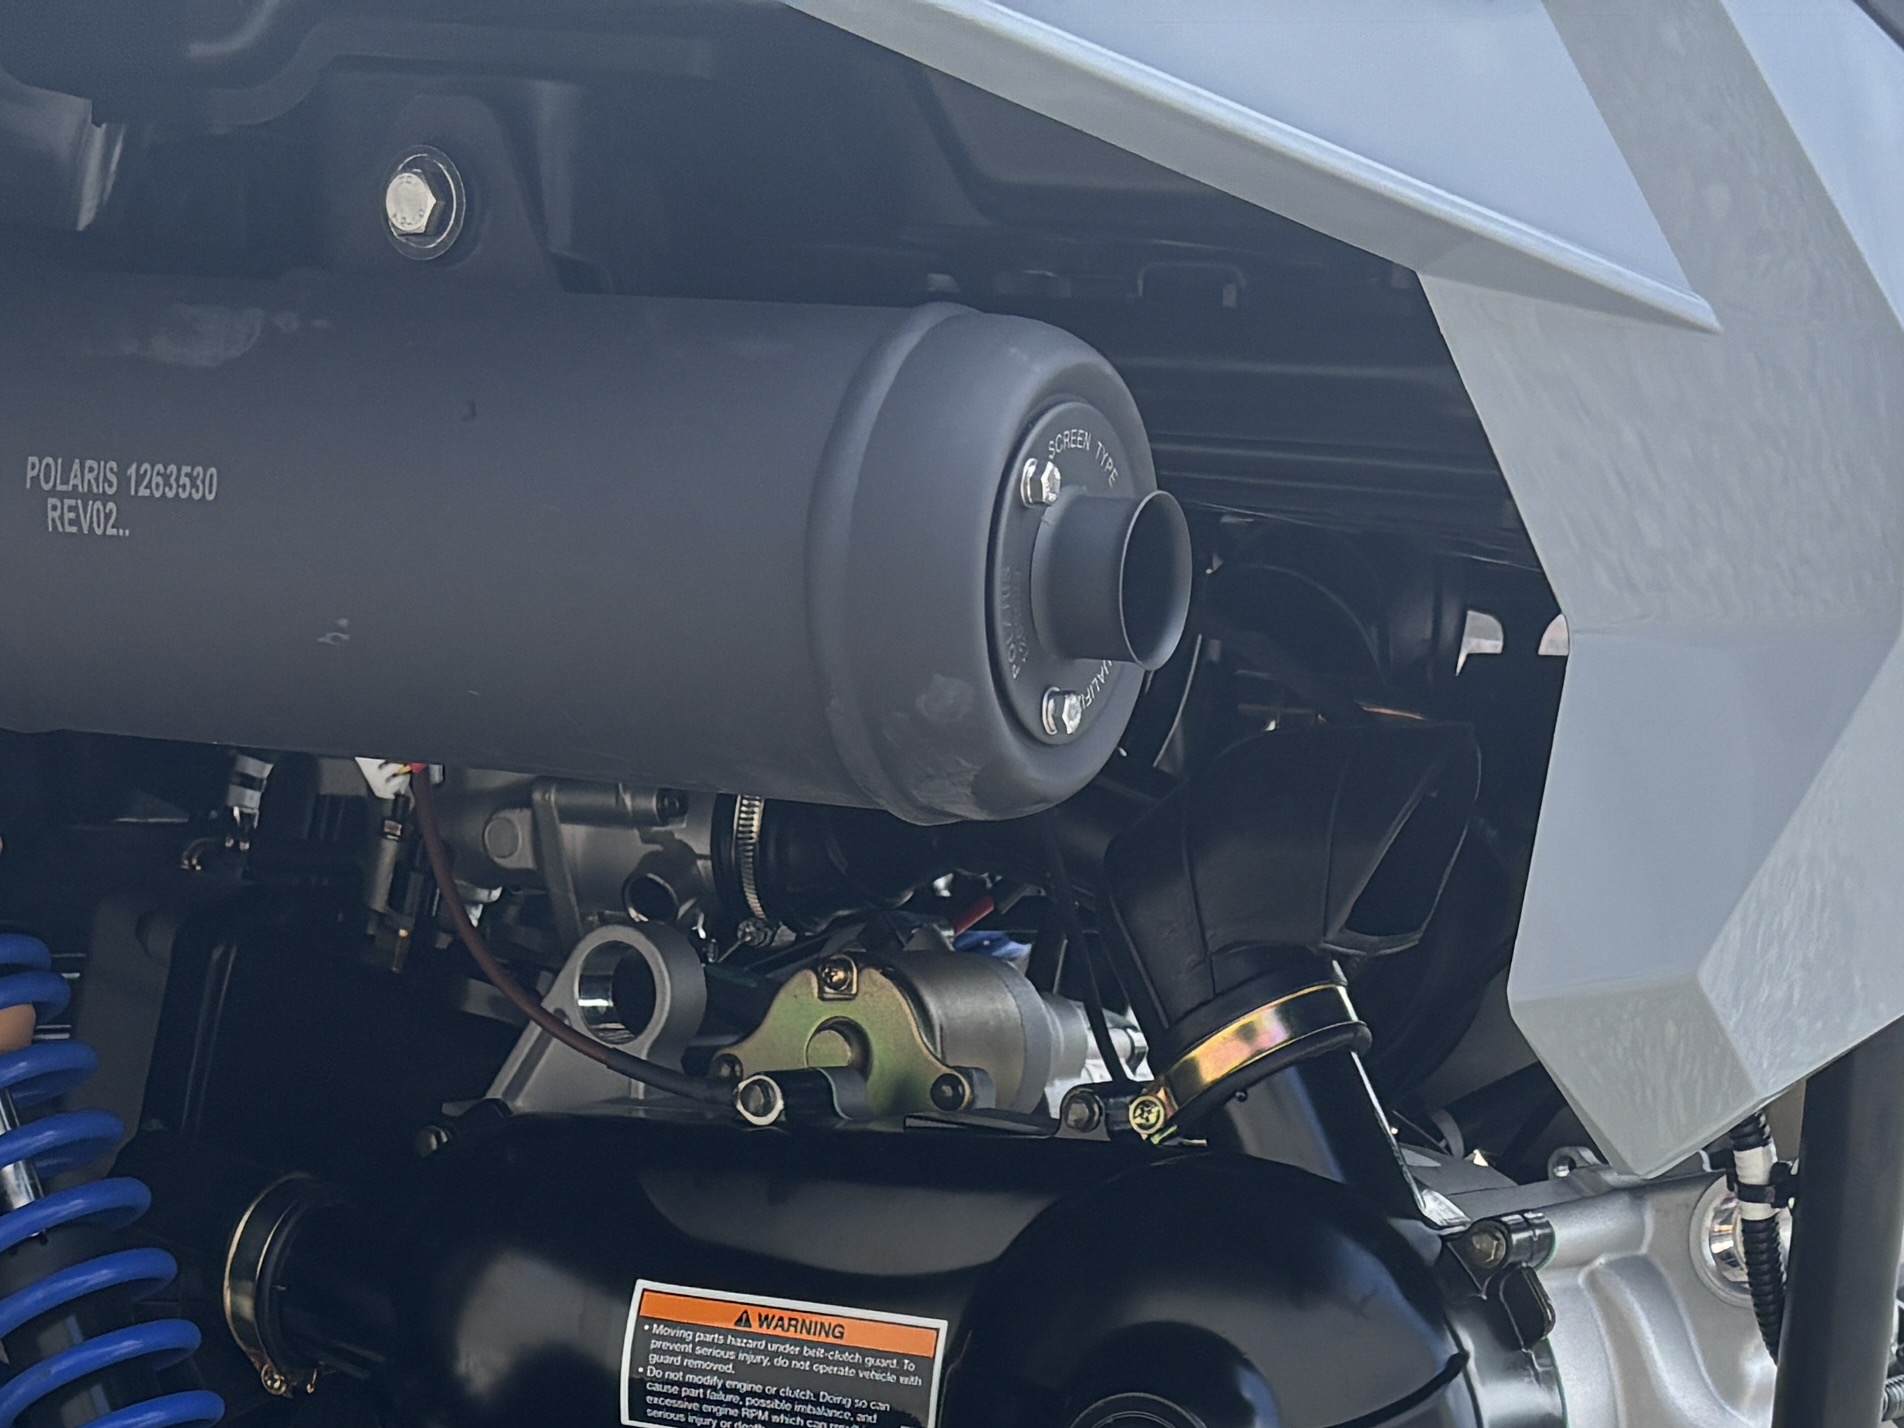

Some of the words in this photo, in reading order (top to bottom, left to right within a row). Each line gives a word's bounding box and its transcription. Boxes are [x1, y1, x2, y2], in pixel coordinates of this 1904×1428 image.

[26, 456, 118, 495] POLARIS
[127, 462, 218, 501] 1263530
[1048, 428, 1091, 460] SCREEN
[1096, 441, 1119, 488] TYPE
[1081, 660, 1113, 710] UALIFI
[652, 1323, 693, 1342] Moving
[695, 1331, 724, 1345] parts
[727, 1335, 766, 1349] hazard
[767, 1341, 801, 1354] under
[802, 1346, 863, 1364] belt-clutch
[903, 1360, 916, 1371] To
[757, 1312, 846, 1340] WARNING
[648, 1352, 681, 1367] guard
[683, 1357, 736, 1373] removed.
[650, 1338, 693, 1355] prevent
[695, 1345, 736, 1360] serious
[773, 1355, 789, 1367] do
[791, 1359, 810, 1370] not
[812, 1362, 856, 1379] operate
[858, 1368, 897, 1382] vehicle
[899, 1374, 922, 1386] with
[646, 1366, 663, 1378] Do
[664, 1370, 683, 1381] not
[685, 1373, 723, 1389] modify
[725, 1380, 763, 1395] engine
[765, 1385, 778, 1395] or
[779, 1386, 815, 1401] clutch.
[819, 1392, 852, 1407] Doing
[854, 1399, 868, 1408] so
[870, 1401, 890, 1411] can
[646, 1382, 679, 1394] cause
[681, 1386, 704, 1399] part
[745, 1395, 793, 1412] possible
[856, 1411, 877, 1423] and
[646, 1395, 700, 1411] excessive
[701, 1403, 739, 1419] engine
[741, 1408, 769, 1421] RPM
[771, 1413, 805, 1427] which
[646, 1408, 686, 1422] serious
[687, 1414, 717, 1428] injury
[719, 1420, 731, 1428] or
